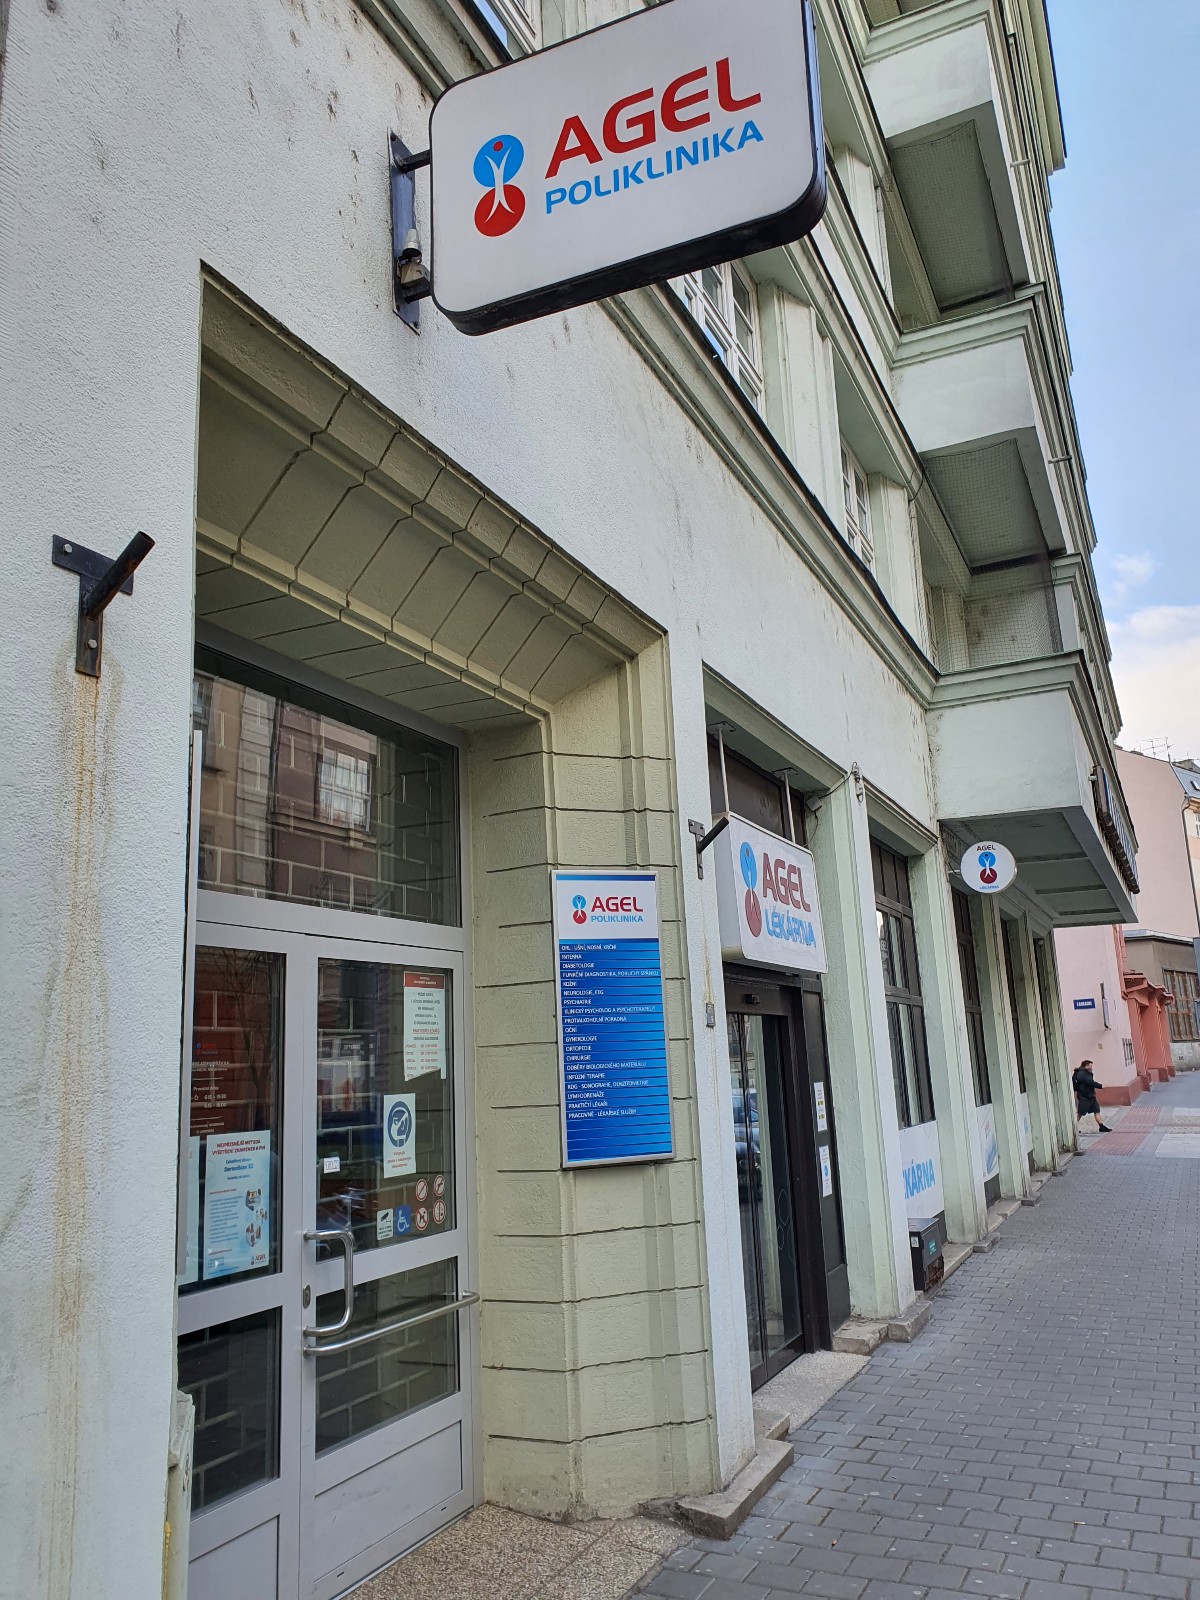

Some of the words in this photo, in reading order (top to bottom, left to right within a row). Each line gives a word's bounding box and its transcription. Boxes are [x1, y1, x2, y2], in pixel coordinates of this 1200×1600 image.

[544, 57, 762, 180] AGEL
[546, 120, 764, 214] POLIKLINIKA
[591, 896, 643, 912] AGEL
[762, 852, 811, 913] AGEL
[902, 1158, 935, 1200] KÁRNA
